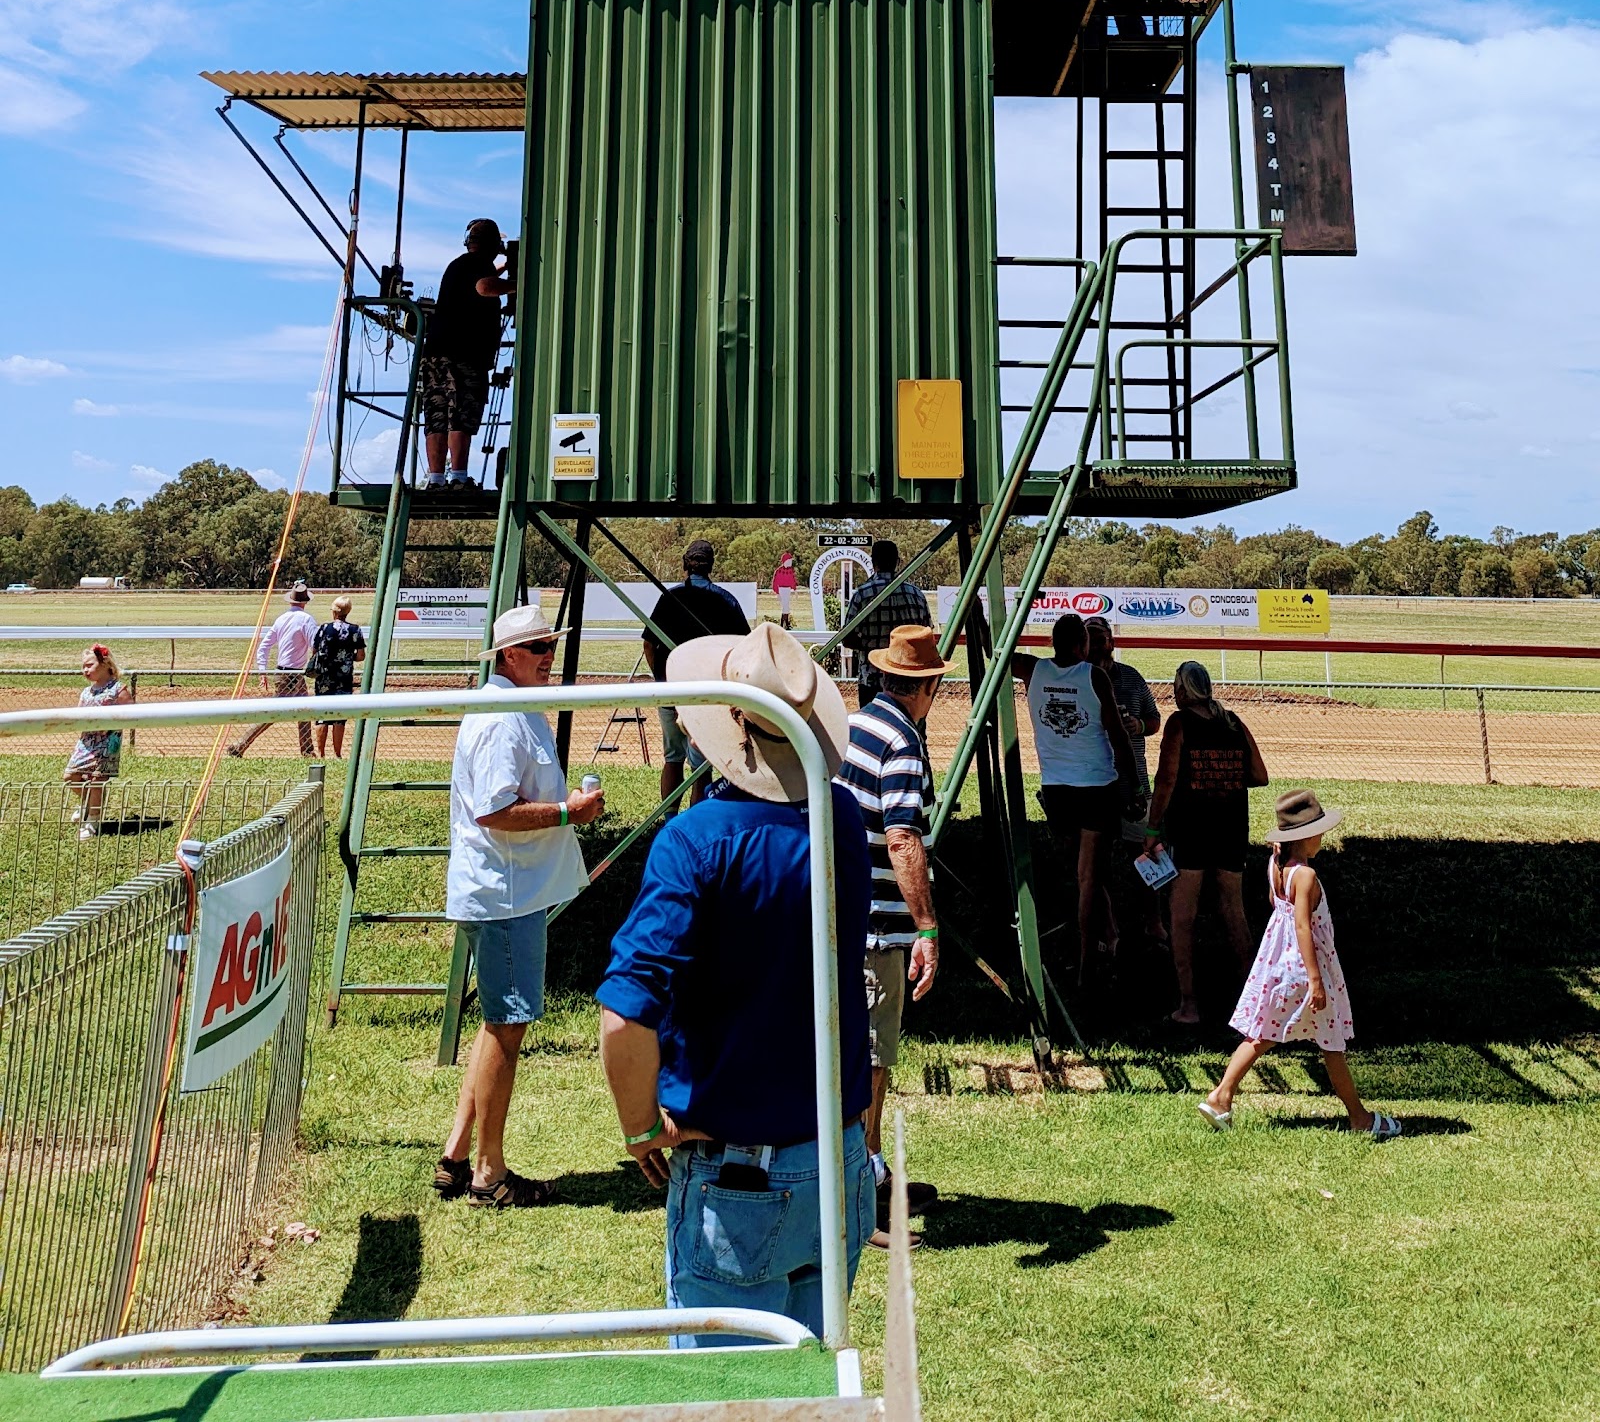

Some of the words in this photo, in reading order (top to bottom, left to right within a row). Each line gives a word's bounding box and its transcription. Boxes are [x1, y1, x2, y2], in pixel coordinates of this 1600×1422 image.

[1261, 81, 1270, 94] 1
[1262, 106, 1274, 118] 2
[1266, 131, 1276, 144] 3
[1268, 157, 1279, 170] 4
[1270, 183, 1282, 196] T
[1270, 208, 1285, 222] M
[911, 441, 951, 449] MAINTAIN
[903, 450, 931, 459] THREE
[933, 450, 959, 459] POINT
[911, 461, 952, 469] CONTACT
[813, 550, 845, 596] CONDOBOLIN
[846, 549, 873, 568] PICNIC
[1031, 598, 1071, 609] SUPA
[1075, 596, 1101, 611] IGA
[1121, 597, 1182, 610] KMWL
[422, 607, 453, 617] Service
[454, 607, 468, 617] Co.
[1221, 608, 1250, 617] MILLING
